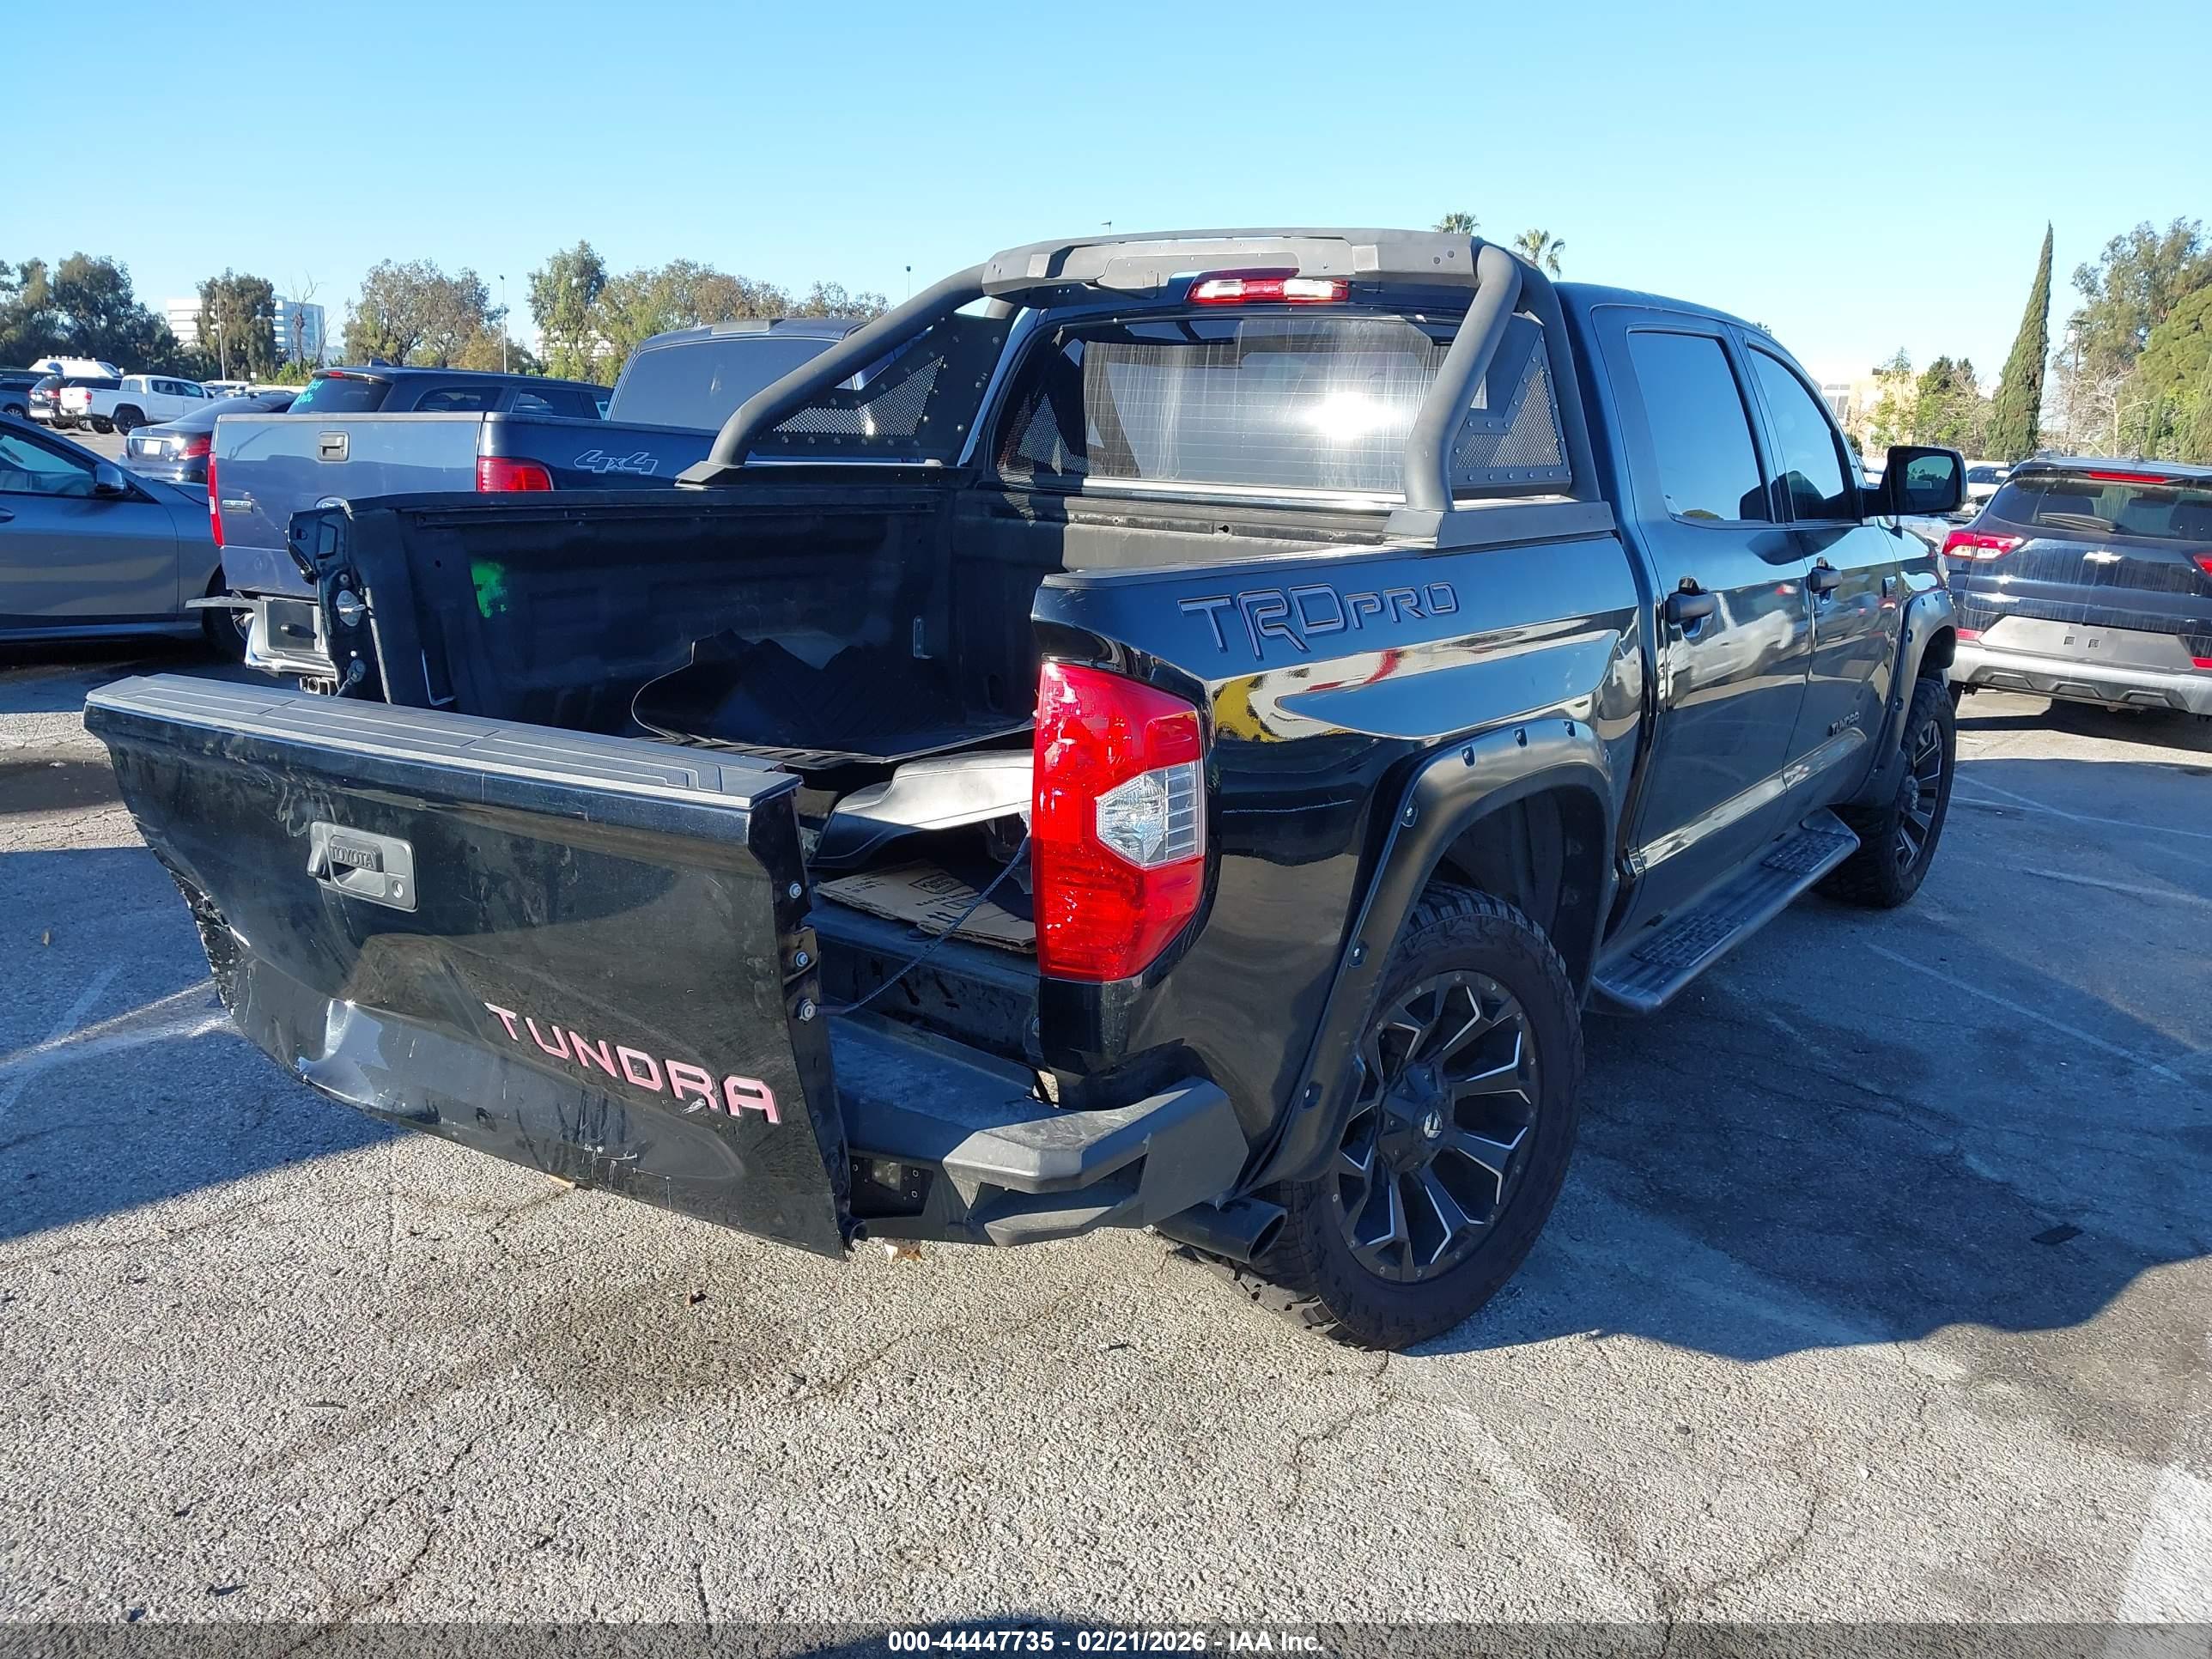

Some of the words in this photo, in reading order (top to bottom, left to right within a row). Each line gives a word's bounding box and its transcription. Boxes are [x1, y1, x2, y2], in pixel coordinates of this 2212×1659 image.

[574, 449, 659, 475] 4x4
[1177, 583, 1346, 661] TRD
[1344, 581, 1459, 629] PRO
[330, 844, 377, 869] TOYOTA
[484, 1002, 782, 1125] TUNDRA
